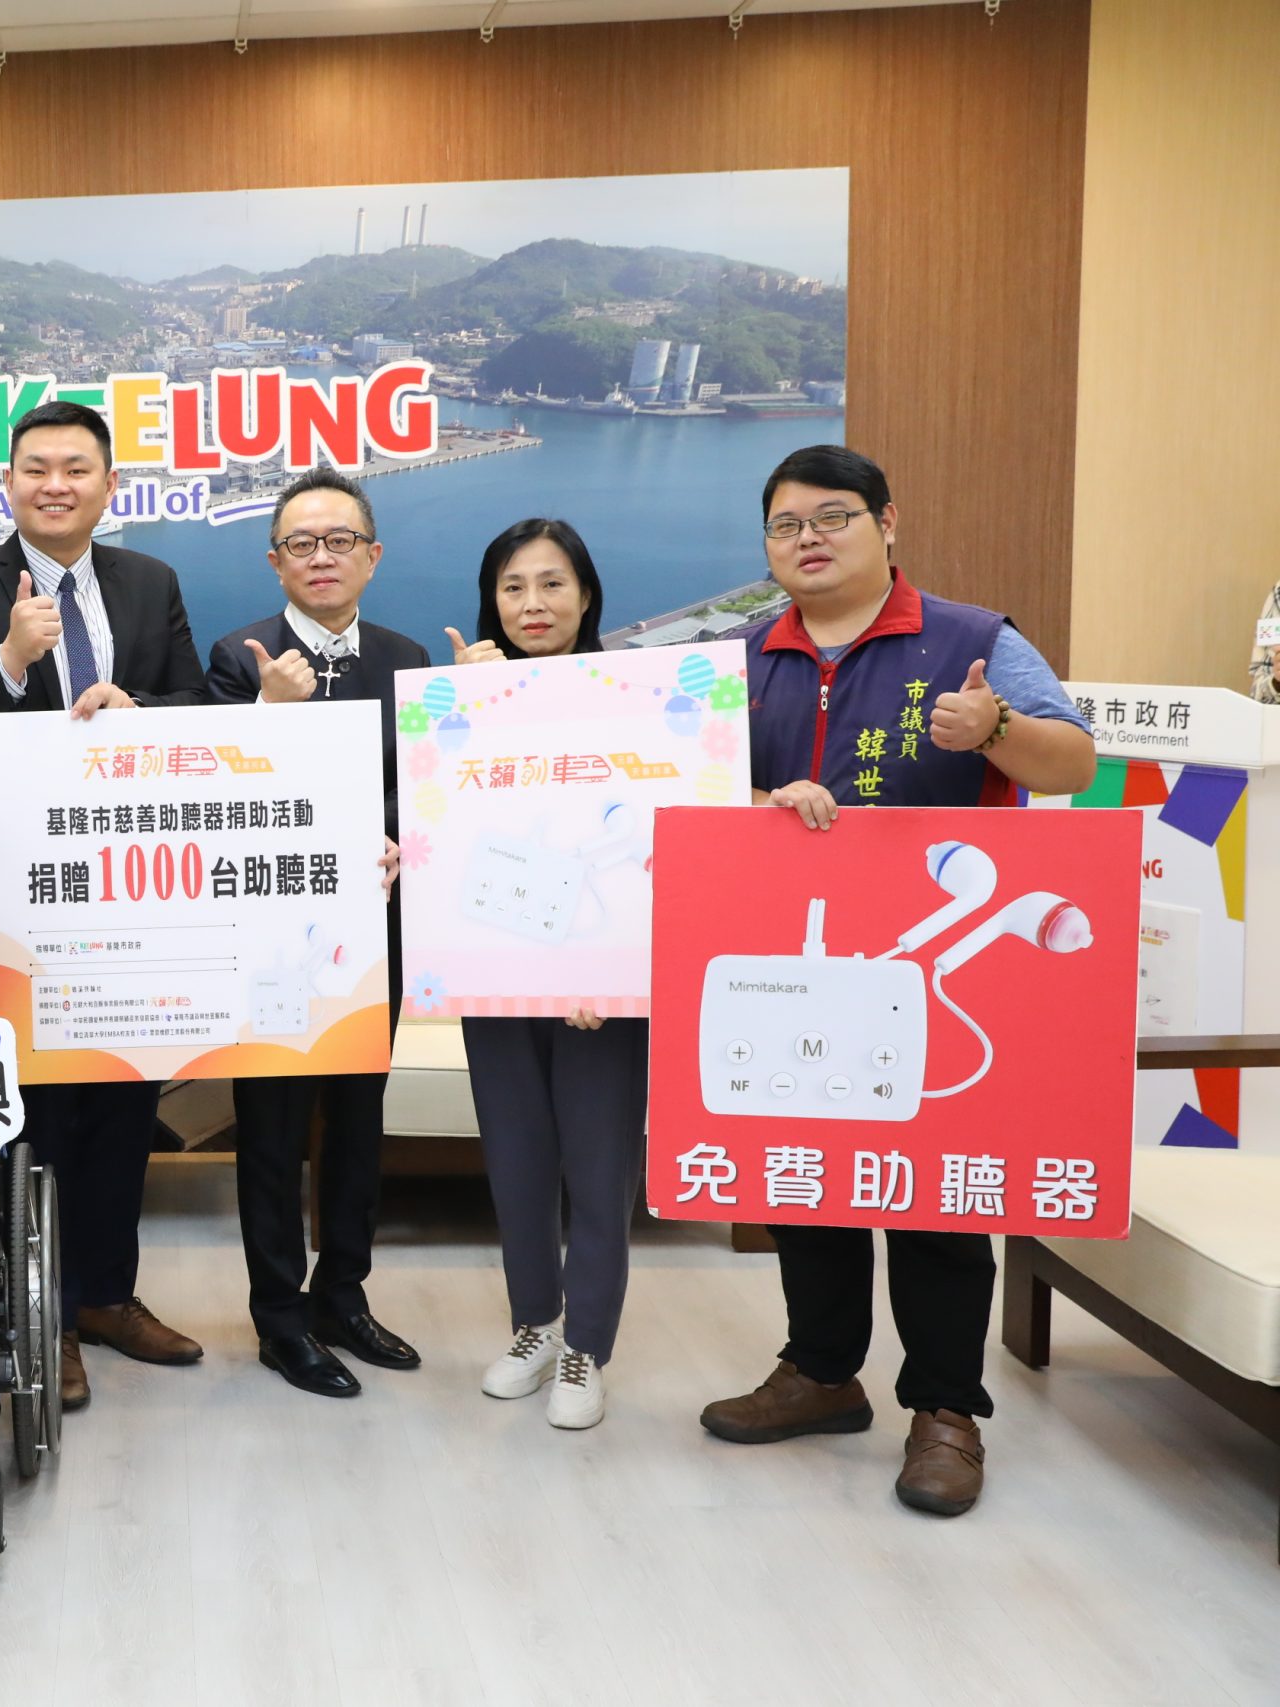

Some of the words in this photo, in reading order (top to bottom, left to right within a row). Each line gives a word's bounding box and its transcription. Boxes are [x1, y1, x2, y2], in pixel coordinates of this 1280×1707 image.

[111, 483, 155, 516] ull
[165, 482, 204, 515] of
[898, 678, 929, 762] 市議員
[1093, 728, 1114, 744] City
[1117, 729, 1190, 747] Government
[854, 727, 888, 805] 韓世
[46, 799, 314, 836] 基隆市慈善助聽器捐助活動
[27, 841, 340, 905] 捐贈1000台助聽器
[728, 981, 808, 994] Mimitakara
[802, 1039, 823, 1057] M
[730, 1079, 750, 1092] NF
[675, 1142, 1098, 1221] 免費助聽器
